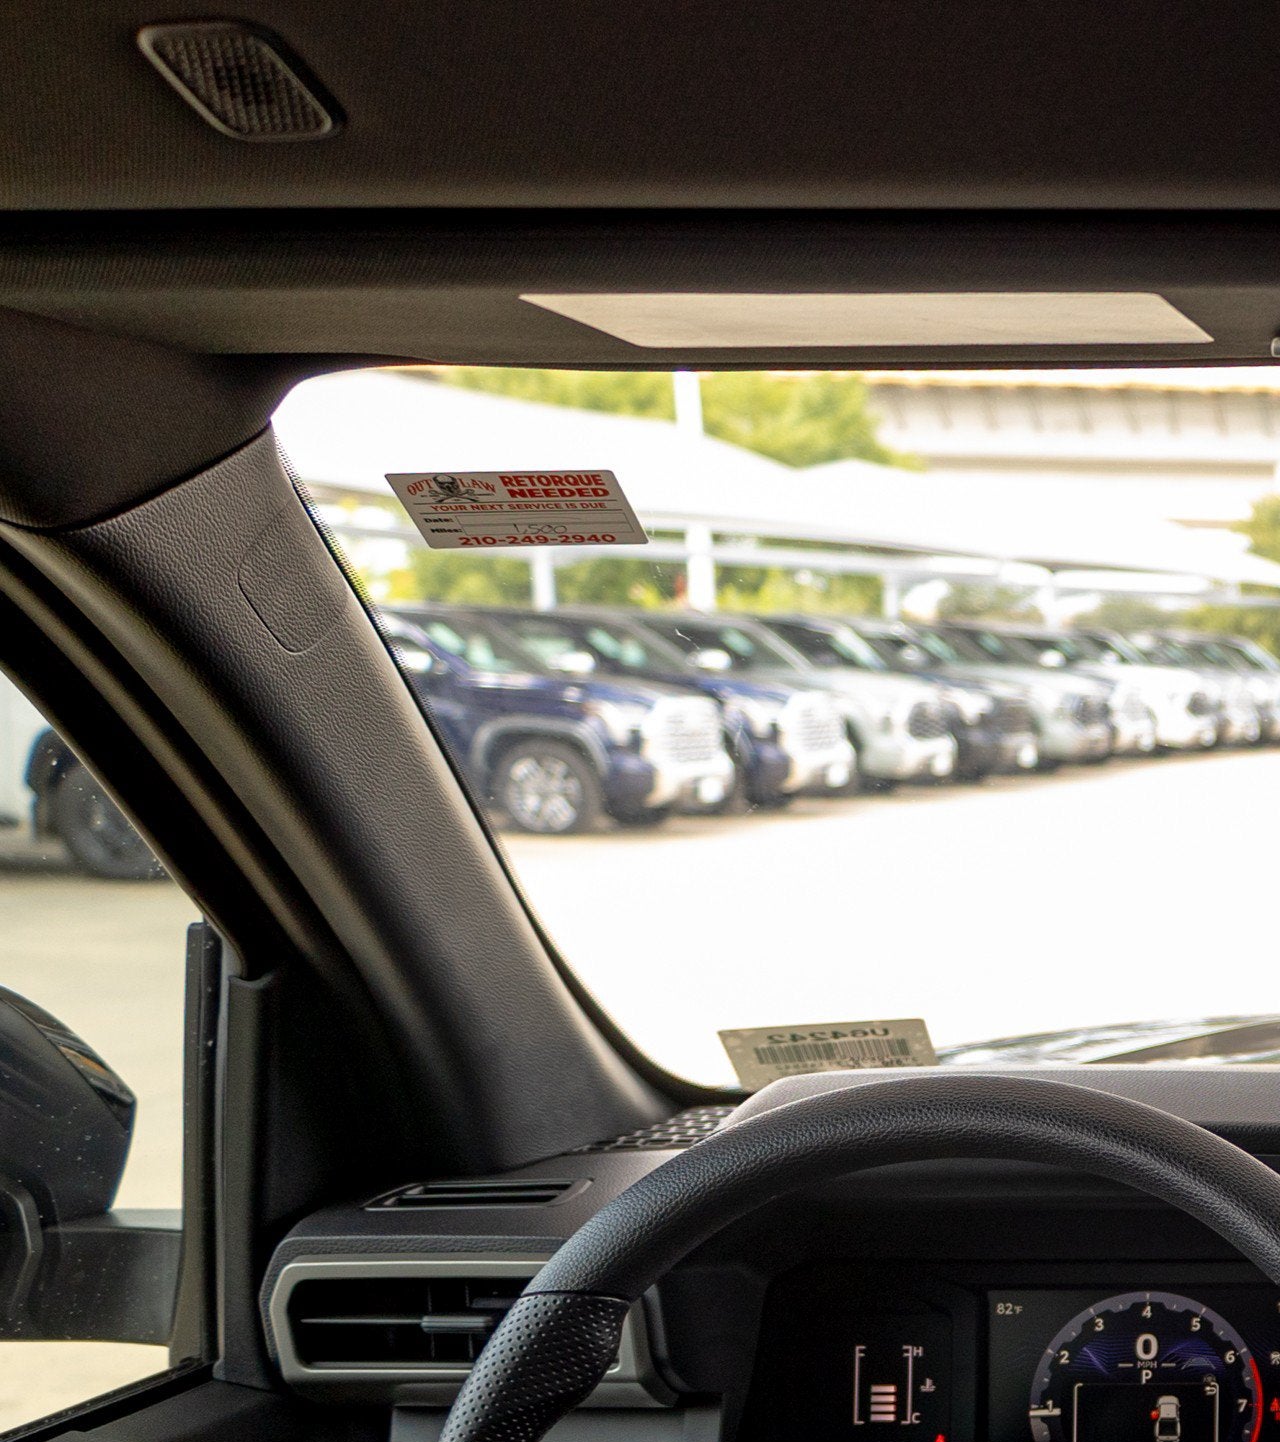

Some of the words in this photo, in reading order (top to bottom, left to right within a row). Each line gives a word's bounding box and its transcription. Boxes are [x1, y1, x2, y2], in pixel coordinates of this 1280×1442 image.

[499, 474, 605, 487] RETORQUE
[507, 487, 610, 498] NEEDED
[430, 504, 468, 512] YOUR
[508, 503, 563, 511] SERVICE
[459, 534, 617, 546] 210-249-2940
[1141, 1306, 1152, 1318] 4
[1094, 1318, 1104, 1331] 3
[1191, 1317, 1201, 1331] 5
[1135, 1333, 1159, 1360] 0
[1059, 1350, 1070, 1364] 2
[1224, 1350, 1235, 1363] 6
[1136, 1360, 1158, 1369] MPH
[1141, 1369, 1153, 1384] P
[1237, 1399, 1248, 1412] 7
